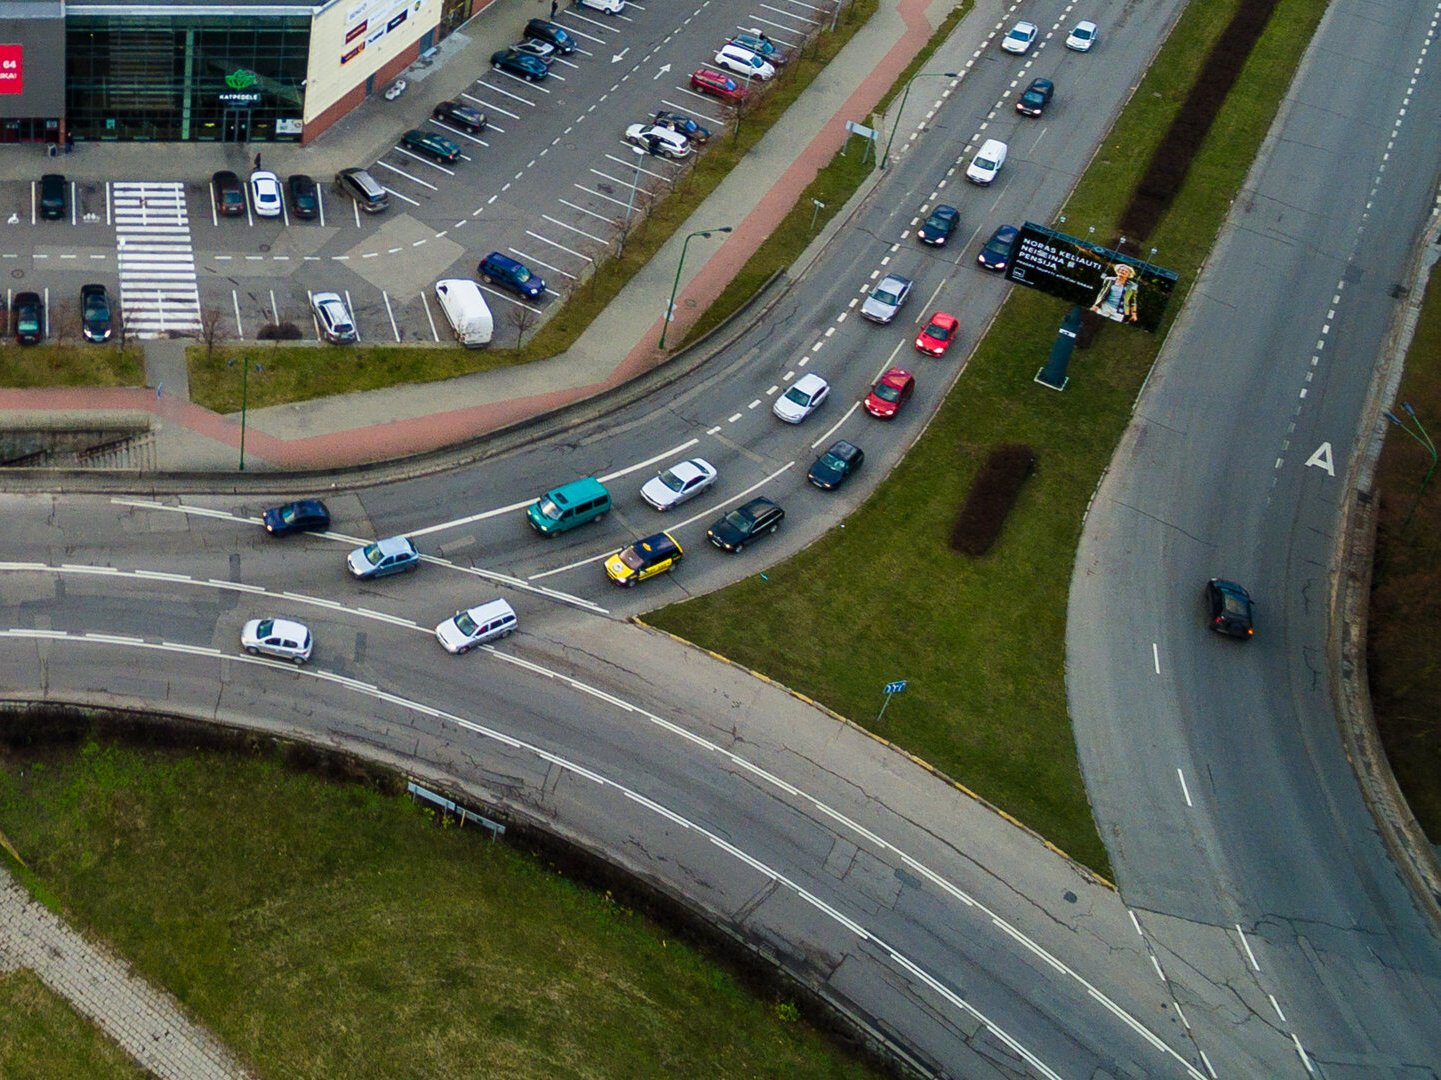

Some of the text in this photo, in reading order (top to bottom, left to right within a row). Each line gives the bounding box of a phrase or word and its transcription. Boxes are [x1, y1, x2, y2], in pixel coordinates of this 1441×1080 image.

[3, 60, 17, 69] 64
[1023, 238, 1057, 255] NORAS
[1059, 250, 1102, 270] KELIAUTI
[1304, 441, 1335, 477] A
